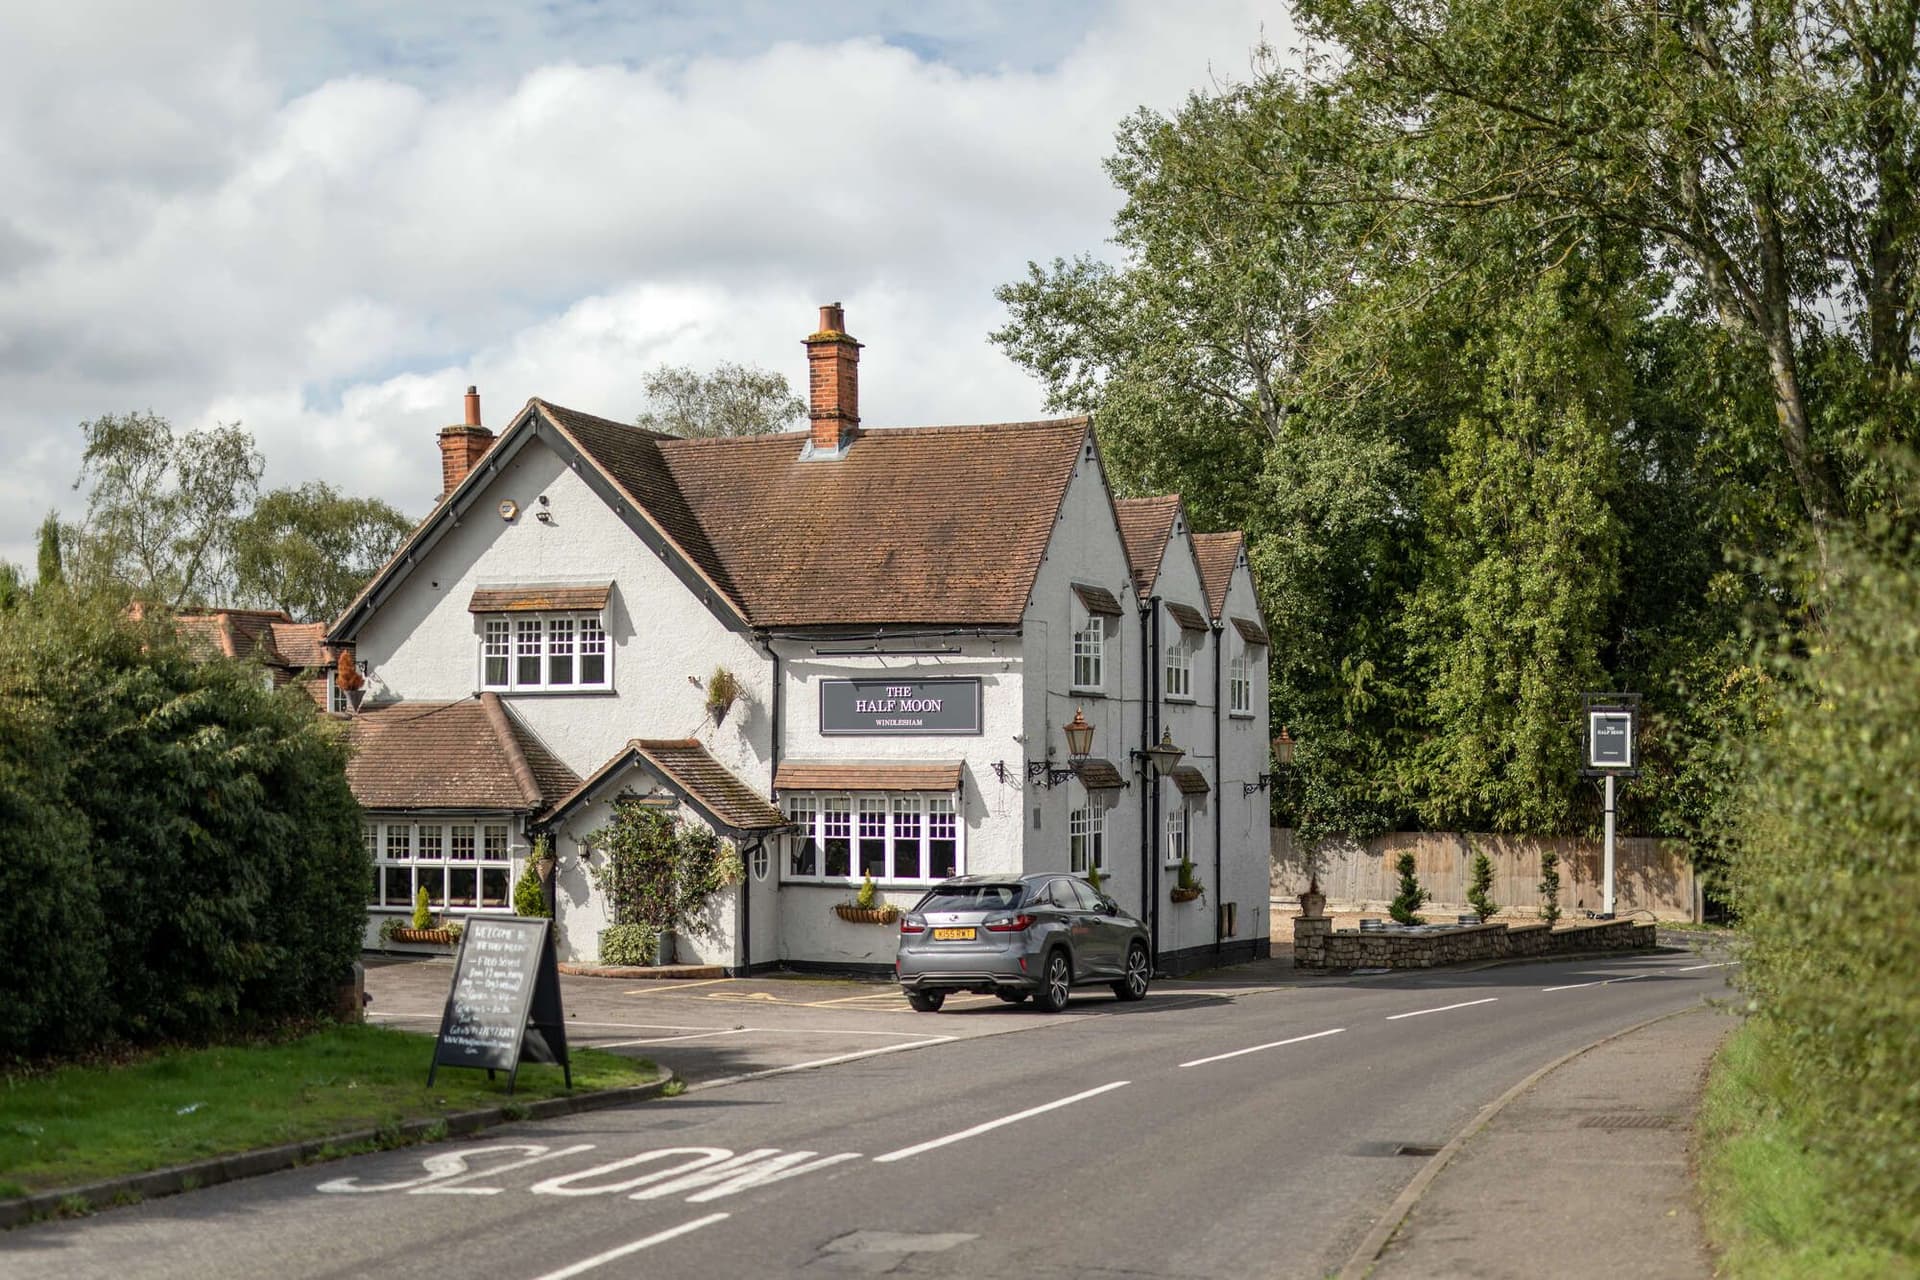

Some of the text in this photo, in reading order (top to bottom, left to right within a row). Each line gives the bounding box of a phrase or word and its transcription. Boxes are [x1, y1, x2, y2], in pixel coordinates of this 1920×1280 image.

[886, 686, 912, 698] THE
[855, 699, 942, 713] HALF MOON
[875, 718, 923, 726] WINDLESHAM
[316, 1143, 864, 1204] SLOW
